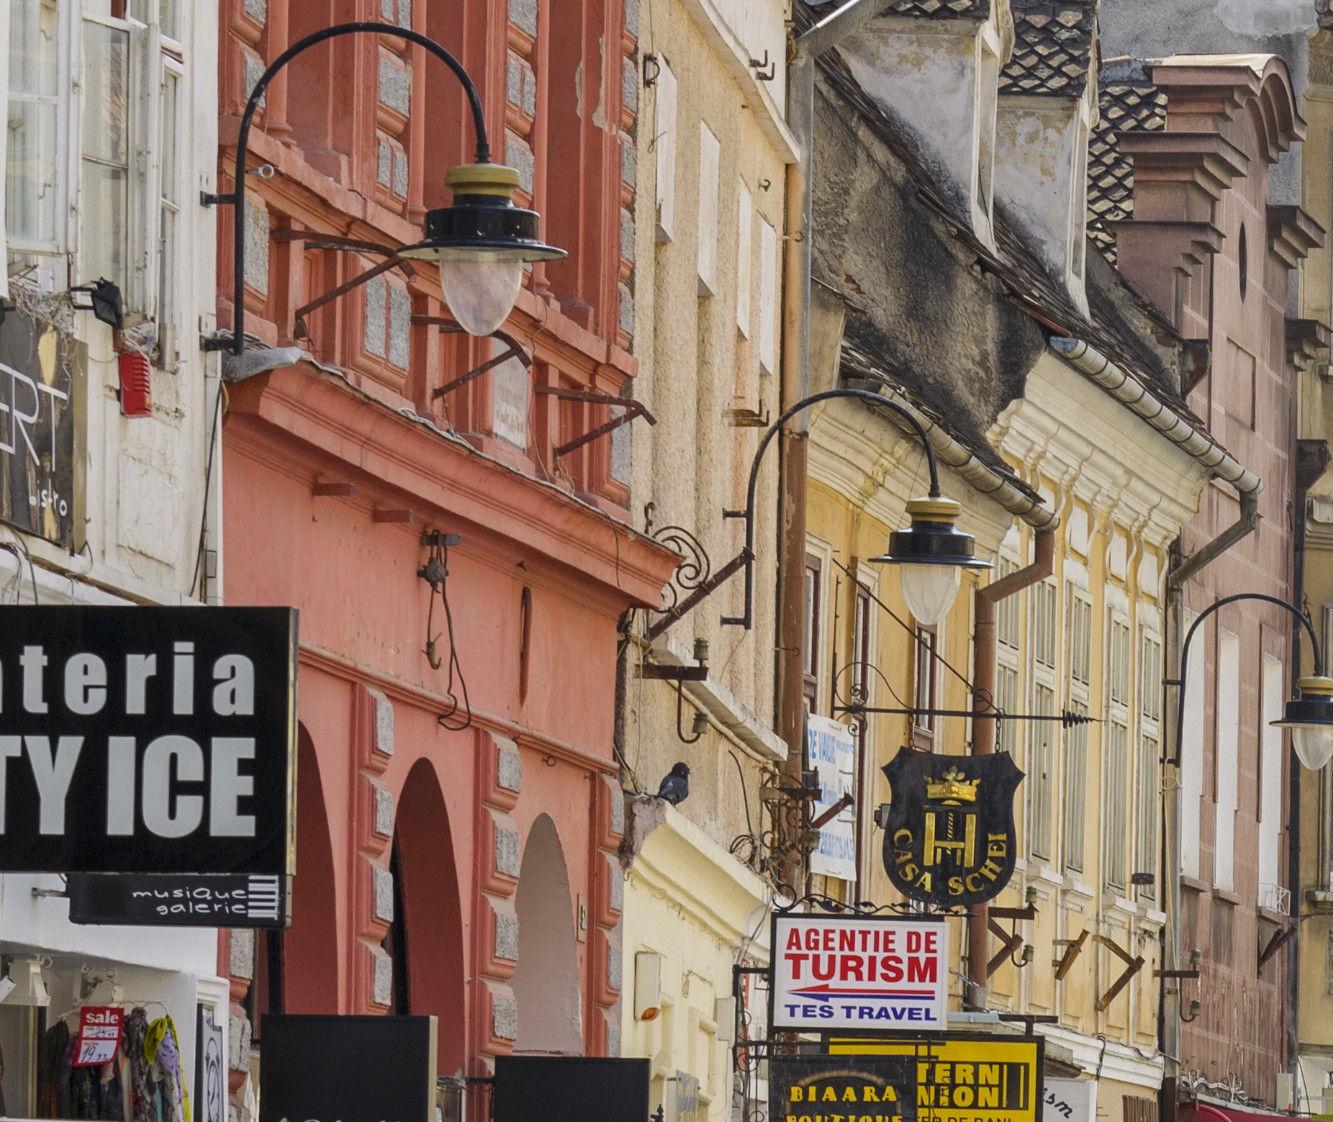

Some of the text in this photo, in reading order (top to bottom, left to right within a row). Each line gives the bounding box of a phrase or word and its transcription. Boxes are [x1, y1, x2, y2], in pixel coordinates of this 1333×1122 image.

[0, 641, 256, 716] teria
[106, 735, 257, 839] ICE
[893, 828, 933, 894] CASA
[947, 832, 1008, 896] SCHEI
[156, 901, 248, 916] galerie
[786, 928, 938, 954] AGENTIE DE
[784, 953, 938, 984] TURISM
[85, 1010, 120, 1025] sale
[784, 1003, 938, 1022] TES TRAVEL
[789, 1085, 898, 1103] BIAARA
